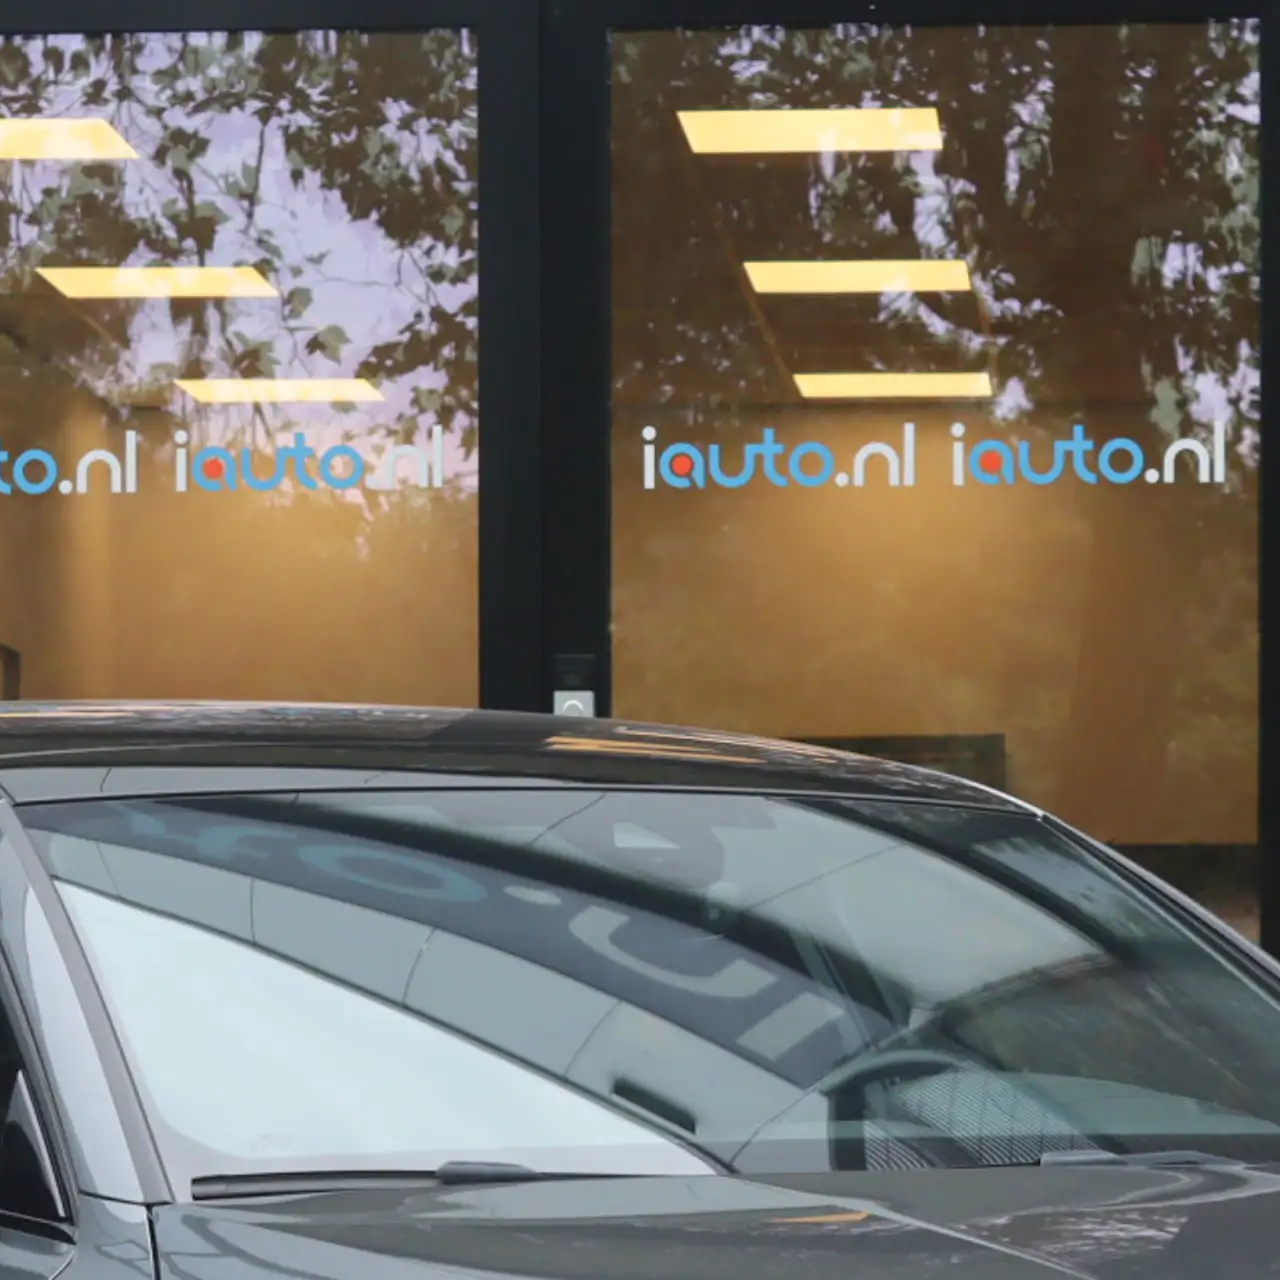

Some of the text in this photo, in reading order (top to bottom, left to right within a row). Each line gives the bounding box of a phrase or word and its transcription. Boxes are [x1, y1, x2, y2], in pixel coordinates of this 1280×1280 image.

[174, 424, 445, 492] iauto.nl
[642, 420, 1227, 489] iauto.nl iauto.nl
